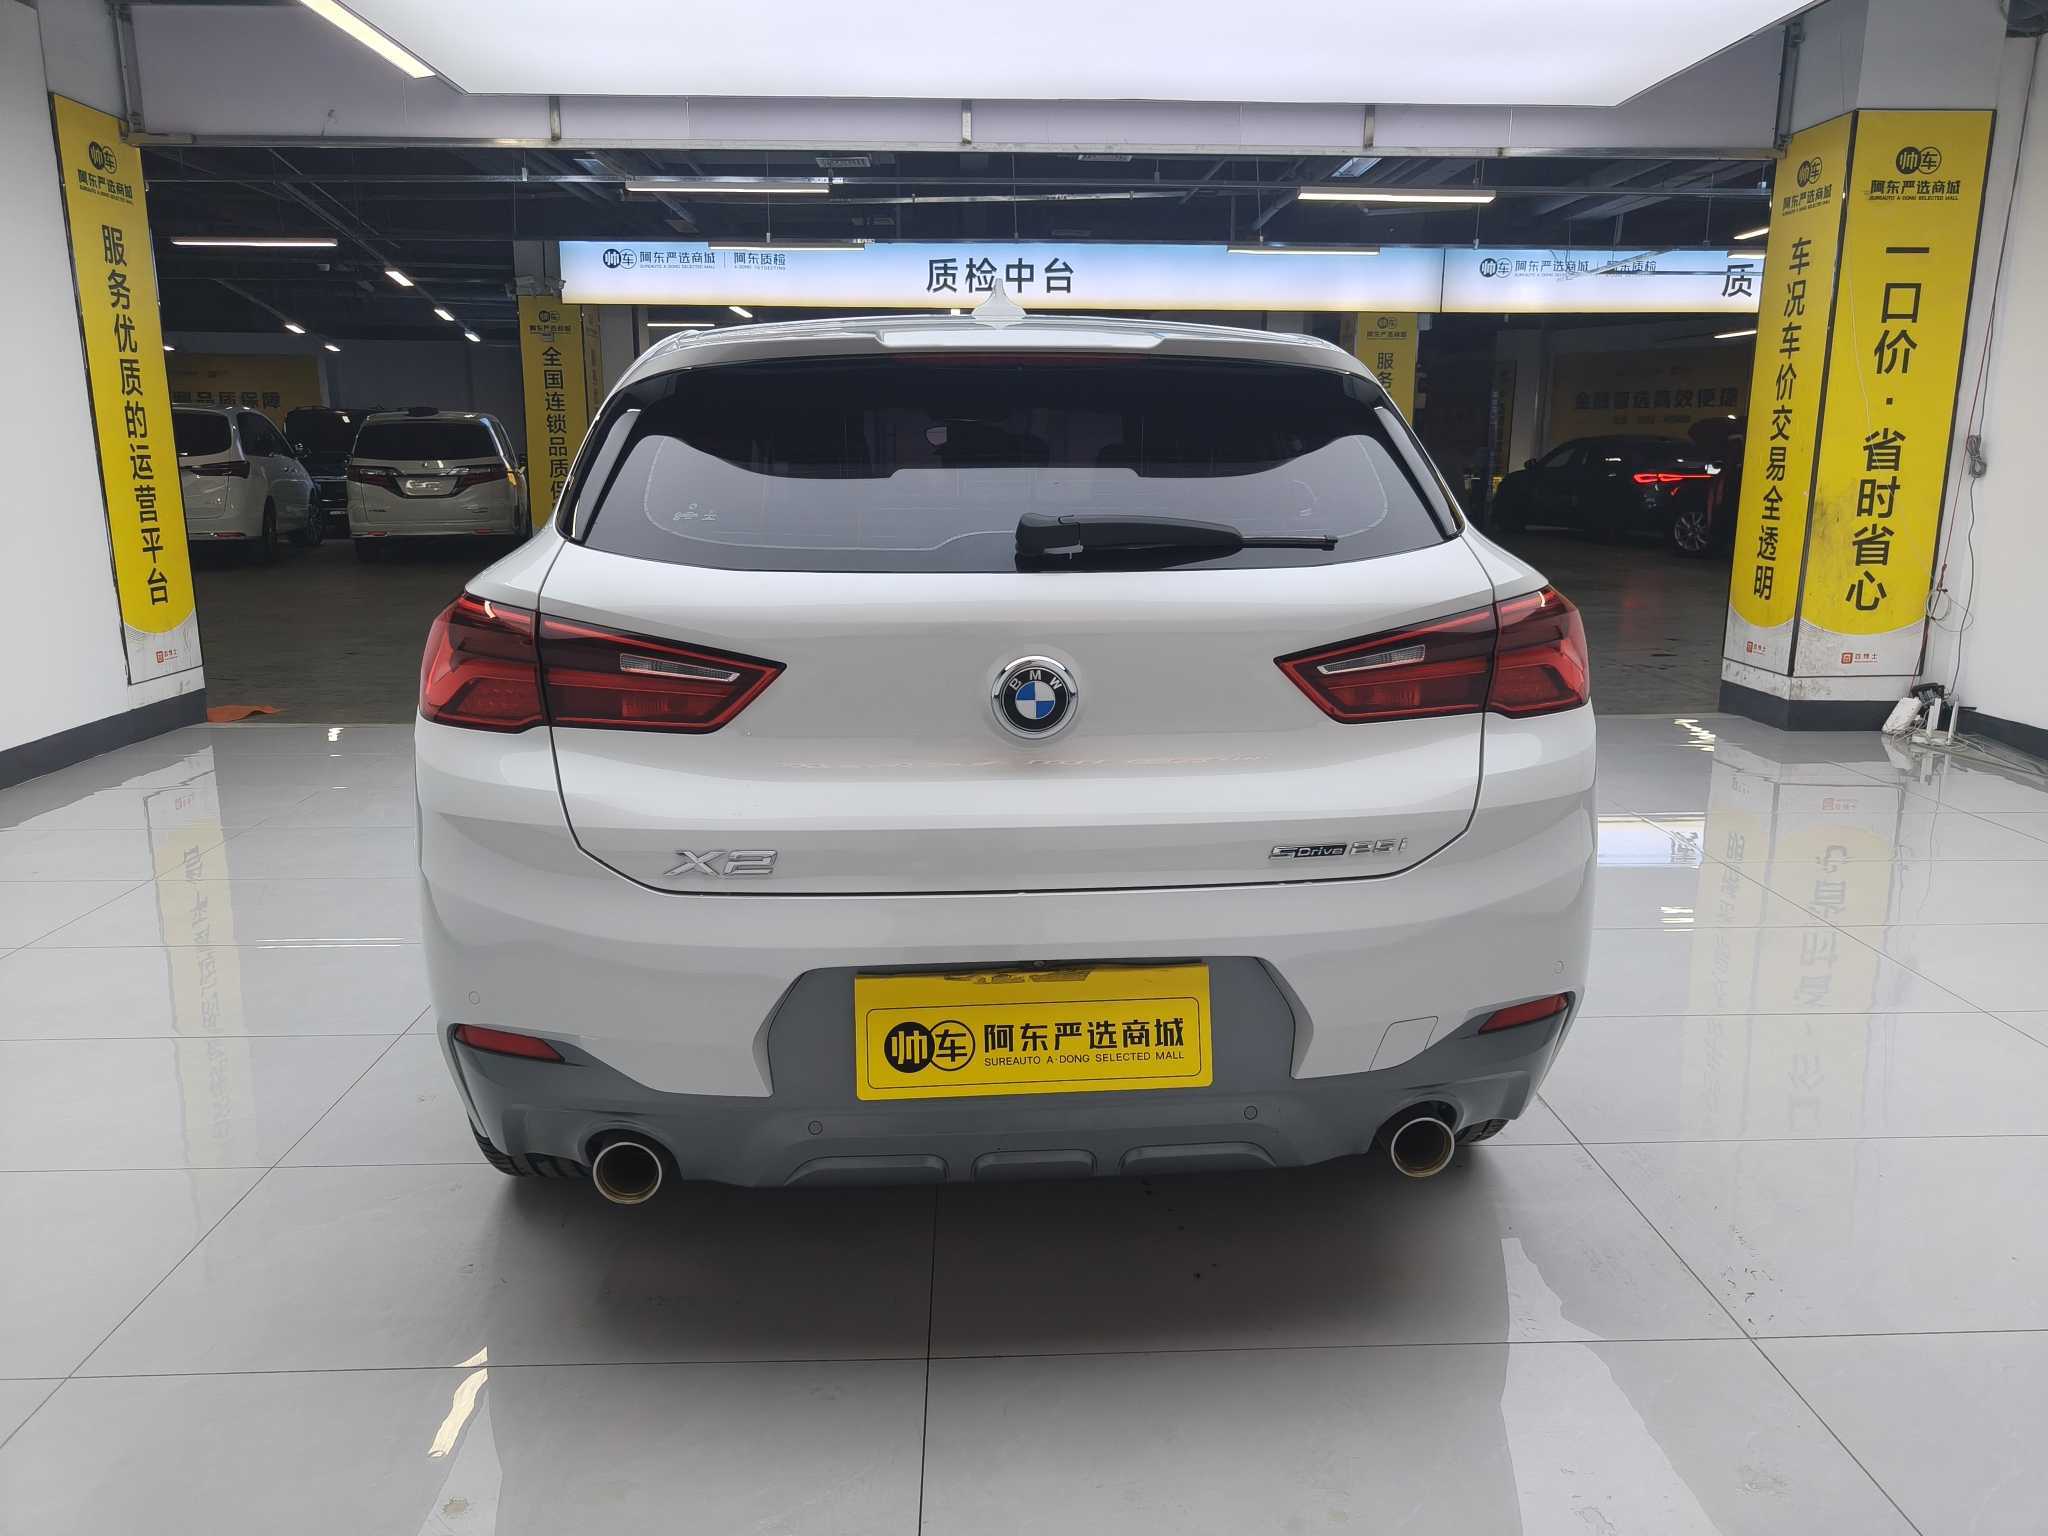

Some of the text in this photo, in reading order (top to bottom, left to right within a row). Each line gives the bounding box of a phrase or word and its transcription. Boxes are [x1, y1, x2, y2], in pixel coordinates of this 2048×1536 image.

[1896, 147, 1942, 174] 帅车
[1870, 180, 1960, 195] 阿东严选商城
[639, 251, 715, 264] 阿东严选商城
[734, 252, 785, 265] 阿东质检
[926, 257, 1074, 293] 质检中台
[1722, 263, 1754, 297] 质
[102, 224, 168, 605] 服务优质的运营平台
[1753, 238, 1811, 601] 车况车价交易全透明
[1009, 669, 1062, 690] BMW
[663, 850, 778, 877] X2
[886, 1018, 1184, 1071] 帅车 阿东严选商城
[984, 1055, 1041, 1067] SUREAUTO
[1095, 1052, 1151, 1063] SELECTED
[1155, 1050, 1185, 1061] MALL
